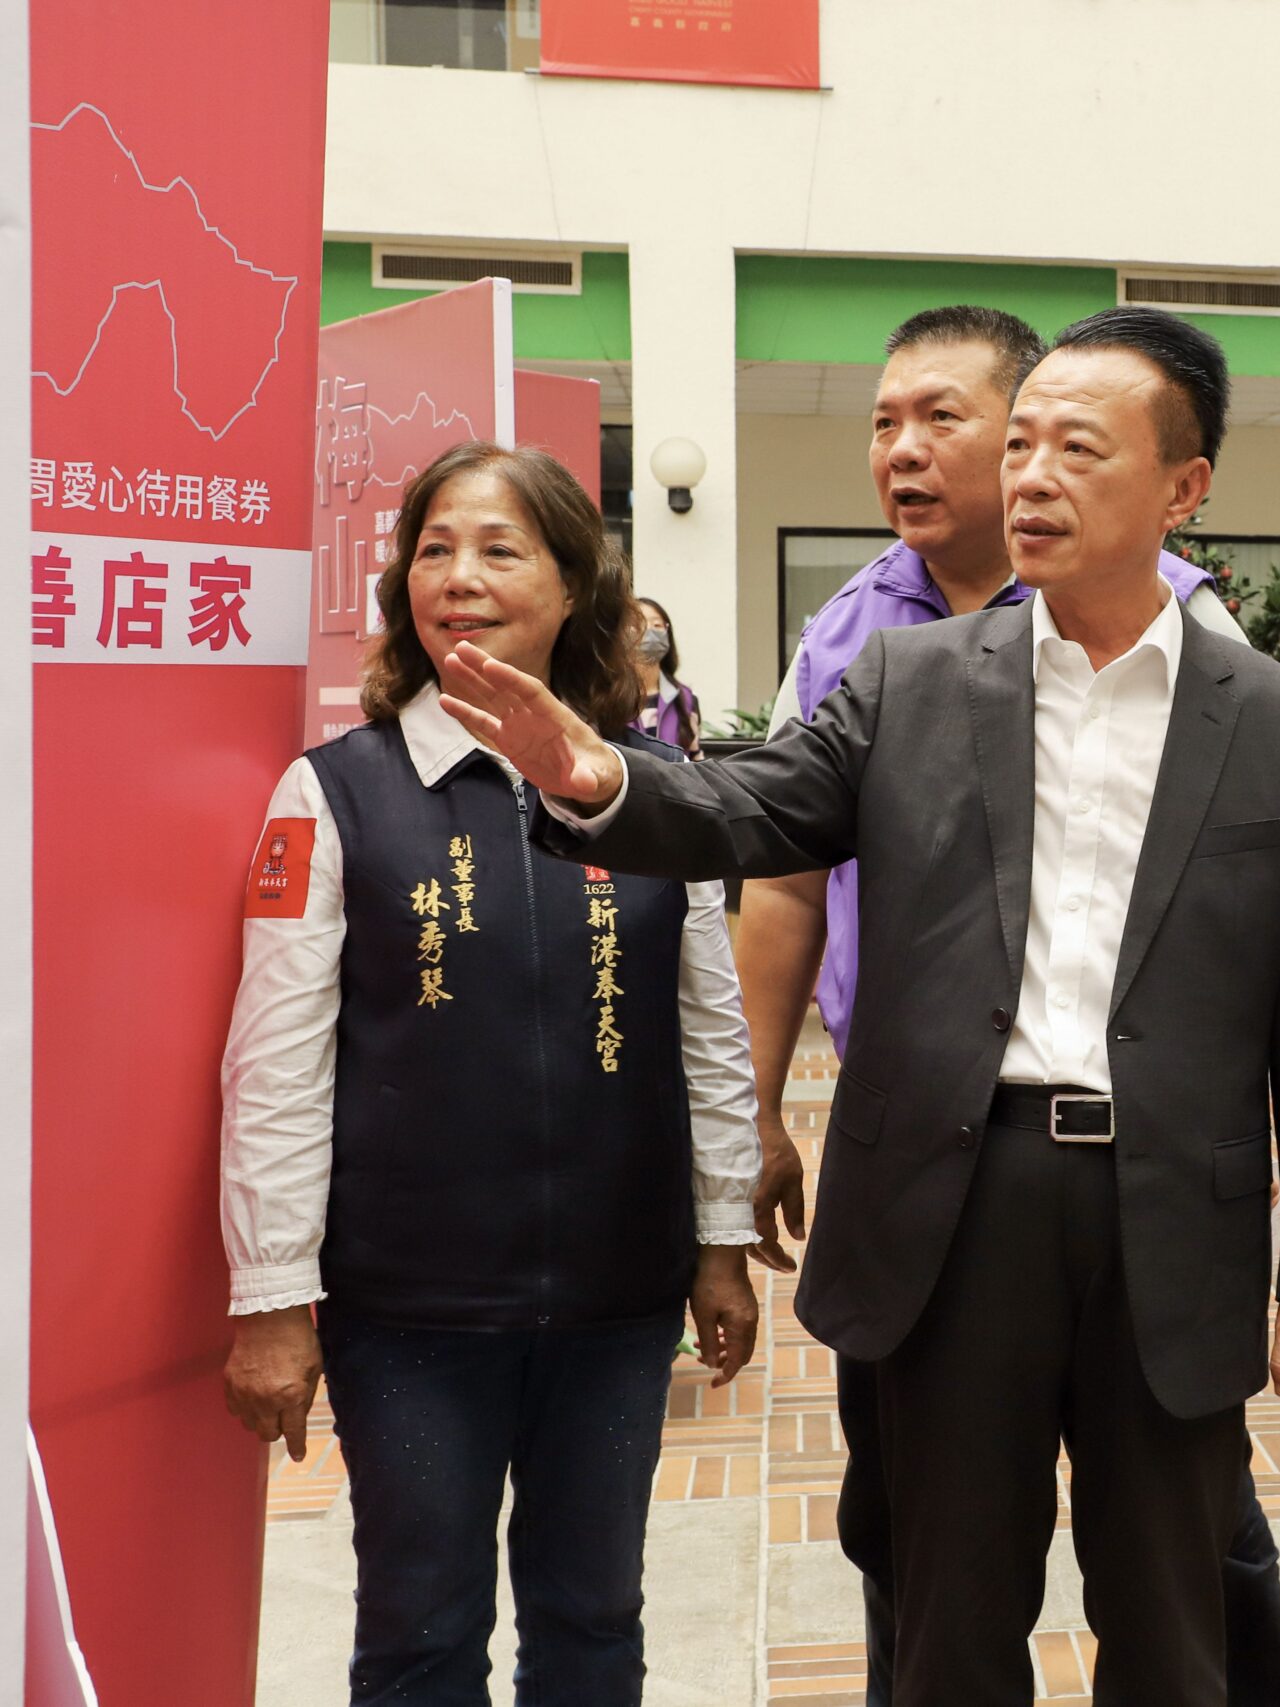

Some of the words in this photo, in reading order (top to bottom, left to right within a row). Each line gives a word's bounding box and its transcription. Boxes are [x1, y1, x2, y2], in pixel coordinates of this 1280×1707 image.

[449, 834, 480, 933] 副董事長
[583, 883, 616, 895] 1622
[410, 878, 454, 1010] 林秀琴
[586, 897, 625, 1073] 新港奉天宮
